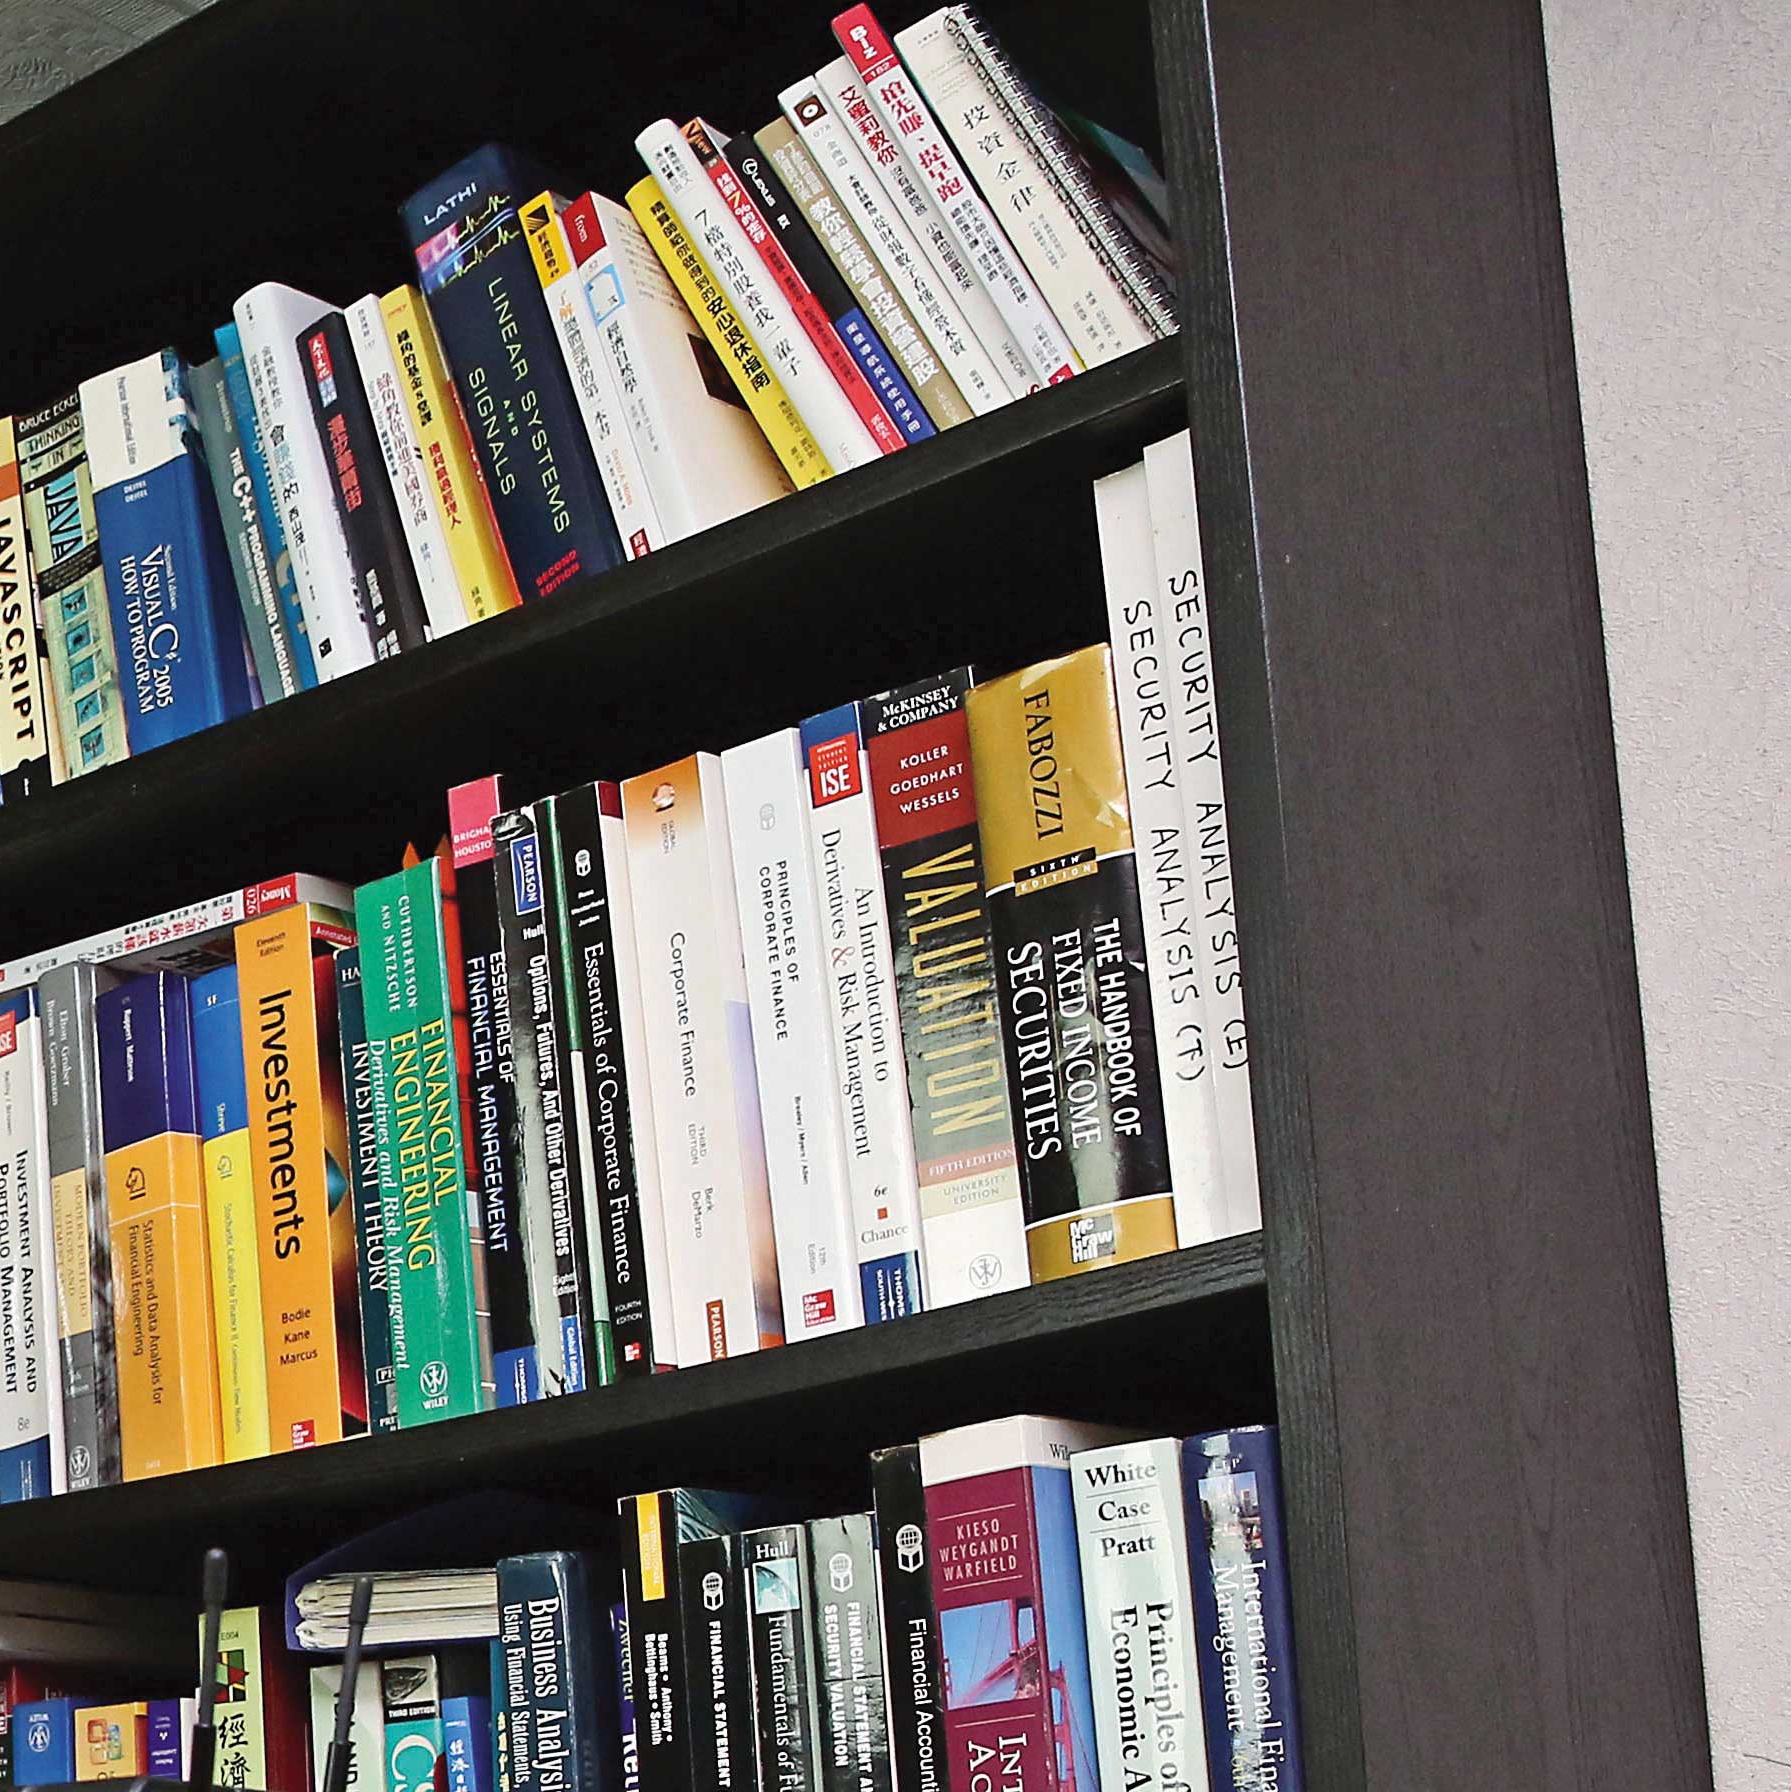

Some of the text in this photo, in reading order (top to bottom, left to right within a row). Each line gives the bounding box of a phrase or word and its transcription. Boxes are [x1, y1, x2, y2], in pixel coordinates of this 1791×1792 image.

[960, 104, 1042, 214] 投資金律
[423, 182, 478, 226] LATHI
[468, 366, 517, 496] SIGNALS
[487, 276, 571, 534] LINEAR SYSTEMS
[502, 398, 520, 437] AND
[25, 415, 81, 451] THINKING
[48, 449, 65, 468] IN
[229, 447, 246, 476] THE
[43, 475, 84, 564] JAVA
[231, 474, 257, 524] C++
[246, 523, 278, 625] PROGRAMMING
[535, 550, 579, 586] SECOND
[539, 563, 581, 596] EDITION
[120, 555, 155, 715] HOW TO PROGRAM
[882, 685, 952, 718] McKINSEY
[820, 764, 852, 799] ISE
[889, 763, 965, 796] GOEDHART
[900, 745, 949, 770] KOLLER
[1023, 689, 1064, 841] FABOZZI
[899, 787, 961, 815] WESSELS
[1123, 600, 1176, 790] SECURITY
[1151, 828, 1201, 1005] ANALYSIS
[1168, 569, 1249, 1070] SECURITY ANALYSIS (E)
[521, 845, 538, 904] PEARSON
[775, 859, 800, 984] PRINCIPLES OF
[381, 905, 401, 1014] AND NITZSCHE
[397, 895, 419, 1010] CUTHBERTSON
[758, 866, 789, 1041] CORPORATE FINANCE
[583, 941, 606, 1048] Essentials
[669, 931, 696, 1098] Corporate Finance
[821, 828, 871, 1159] Derivatives & Risk Management
[901, 842, 1007, 1137] VALUATION
[595, 1052, 616, 1074] of
[1006, 941, 1062, 1161] SECURITIES
[1051, 928, 1102, 1149] FIXED INCOME
[258, 990, 304, 1261] Investments
[420, 1018, 459, 1208] FINANCIAL
[467, 956, 508, 1252] FINANCIAL MANAGEMENT
[389, 1030, 437, 1273] ENGINEERING
[596, 1079, 621, 1191] Corporate
[687, 1123, 700, 1165] EDITION
[697, 1126, 707, 1157] THIRD
[704, 1187, 713, 1212] Berk
[873, 1184, 889, 1198] 6e
[943, 1175, 1008, 1197] UNIVERSITY
[953, 1187, 1000, 1205] EDITION
[608, 1194, 630, 1284] Finance
[691, 1191, 703, 1239] DeMarzo
[860, 1224, 909, 1246] Chance
[16, 1149, 38, 1395] INVESTMENT ANALYSIS AND
[0, 1266, 17, 1395] MANAGEMENT
[280, 1307, 312, 1324] Bodie
[614, 1300, 642, 1312] FOURTH
[616, 1312, 643, 1326] EDITION
[278, 1348, 319, 1366] Marcus
[283, 1328, 312, 1344] Kane
[710, 1305, 725, 1360] PEARSON
[1084, 1461, 1157, 1488] White
[955, 1518, 1001, 1540] KIESO
[1097, 1500, 1152, 1523] Case
[755, 1542, 789, 1560] Hull
[938, 1534, 1019, 1564] WEYGANDT
[942, 1555, 1018, 1582] WARFIELD
[1100, 1533, 1157, 1558] Pratt
[527, 1596, 560, 1698] Business
[907, 1618, 929, 1707] Financial
[1240, 1557, 1283, 1738] International
[644, 1634, 662, 1746] Bettinghaus Smith
[657, 1633, 673, 1732] Beams Anthony
[1108, 1604, 1144, 1762] Economic
[388, 1707, 436, 1718] THIRD EDITION
